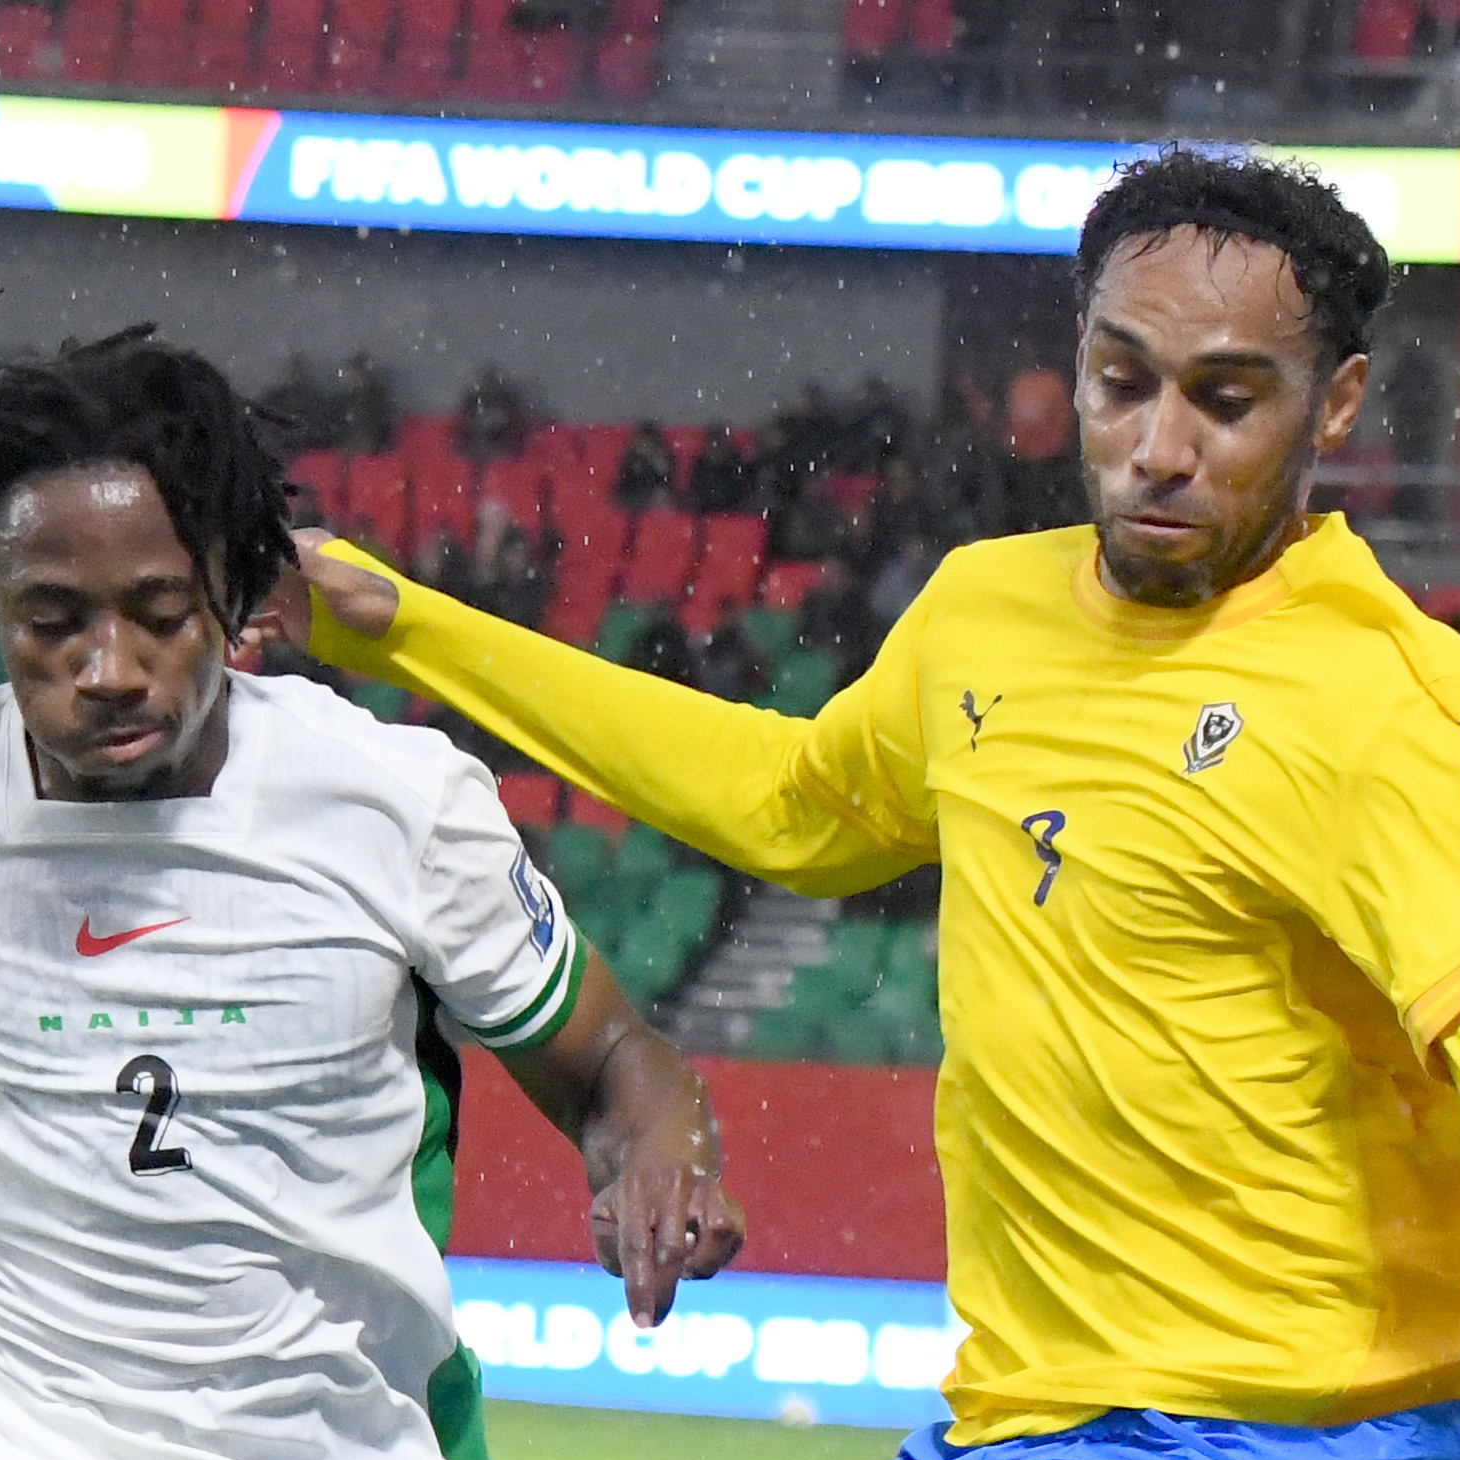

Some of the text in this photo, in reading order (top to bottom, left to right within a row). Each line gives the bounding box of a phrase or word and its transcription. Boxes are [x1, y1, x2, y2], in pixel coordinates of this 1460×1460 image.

[291, 136, 447, 205] FIFA
[450, 144, 712, 215] WORLD
[714, 154, 864, 220] CUP
[39, 1006, 246, 1031] NAIJA
[116, 1054, 192, 1177] 2
[606, 1309, 754, 1378] CUP
